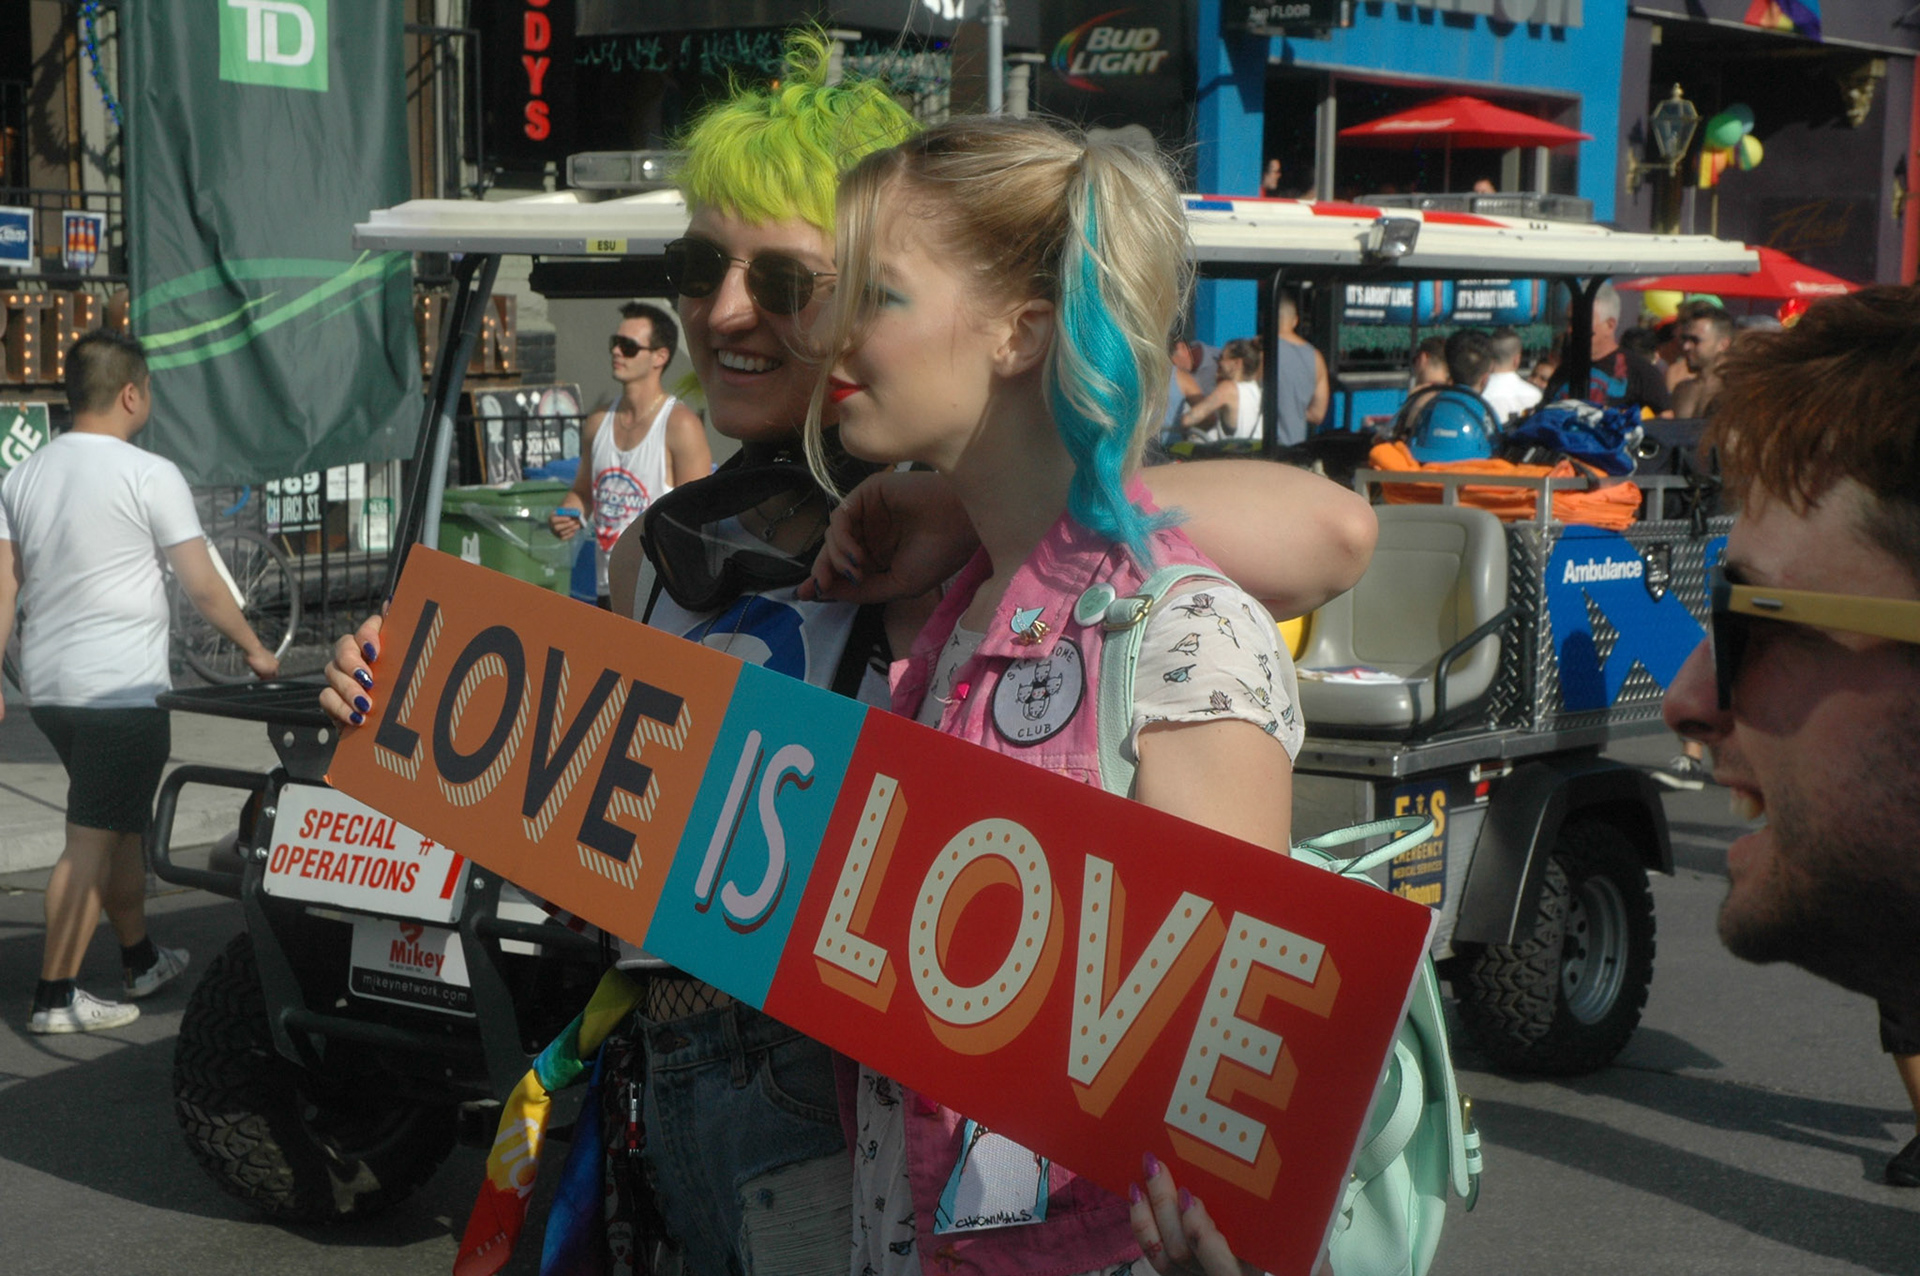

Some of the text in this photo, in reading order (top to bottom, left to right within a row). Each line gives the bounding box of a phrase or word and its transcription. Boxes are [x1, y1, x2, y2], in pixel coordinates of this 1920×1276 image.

[1271, 3, 1311, 19] FLOOR
[227, 0, 315, 66] TD
[1086, 26, 1160, 51] BUD
[521, 0, 551, 141] DYS
[1070, 50, 1168, 75] LIGHT
[597, 240, 616, 251] ESU
[1562, 557, 1643, 584] Ambulance
[1017, 723, 1052, 738] CLUB
[299, 808, 397, 850] SPECIAL
[1394, 790, 1446, 839] ES
[269, 843, 420, 893] OPERATIONS
[374, 599, 1341, 1199] LOVE IS LOVE
[390, 940, 445, 977] Mikey
[362, 974, 467, 1001] mikeynetwork.com
